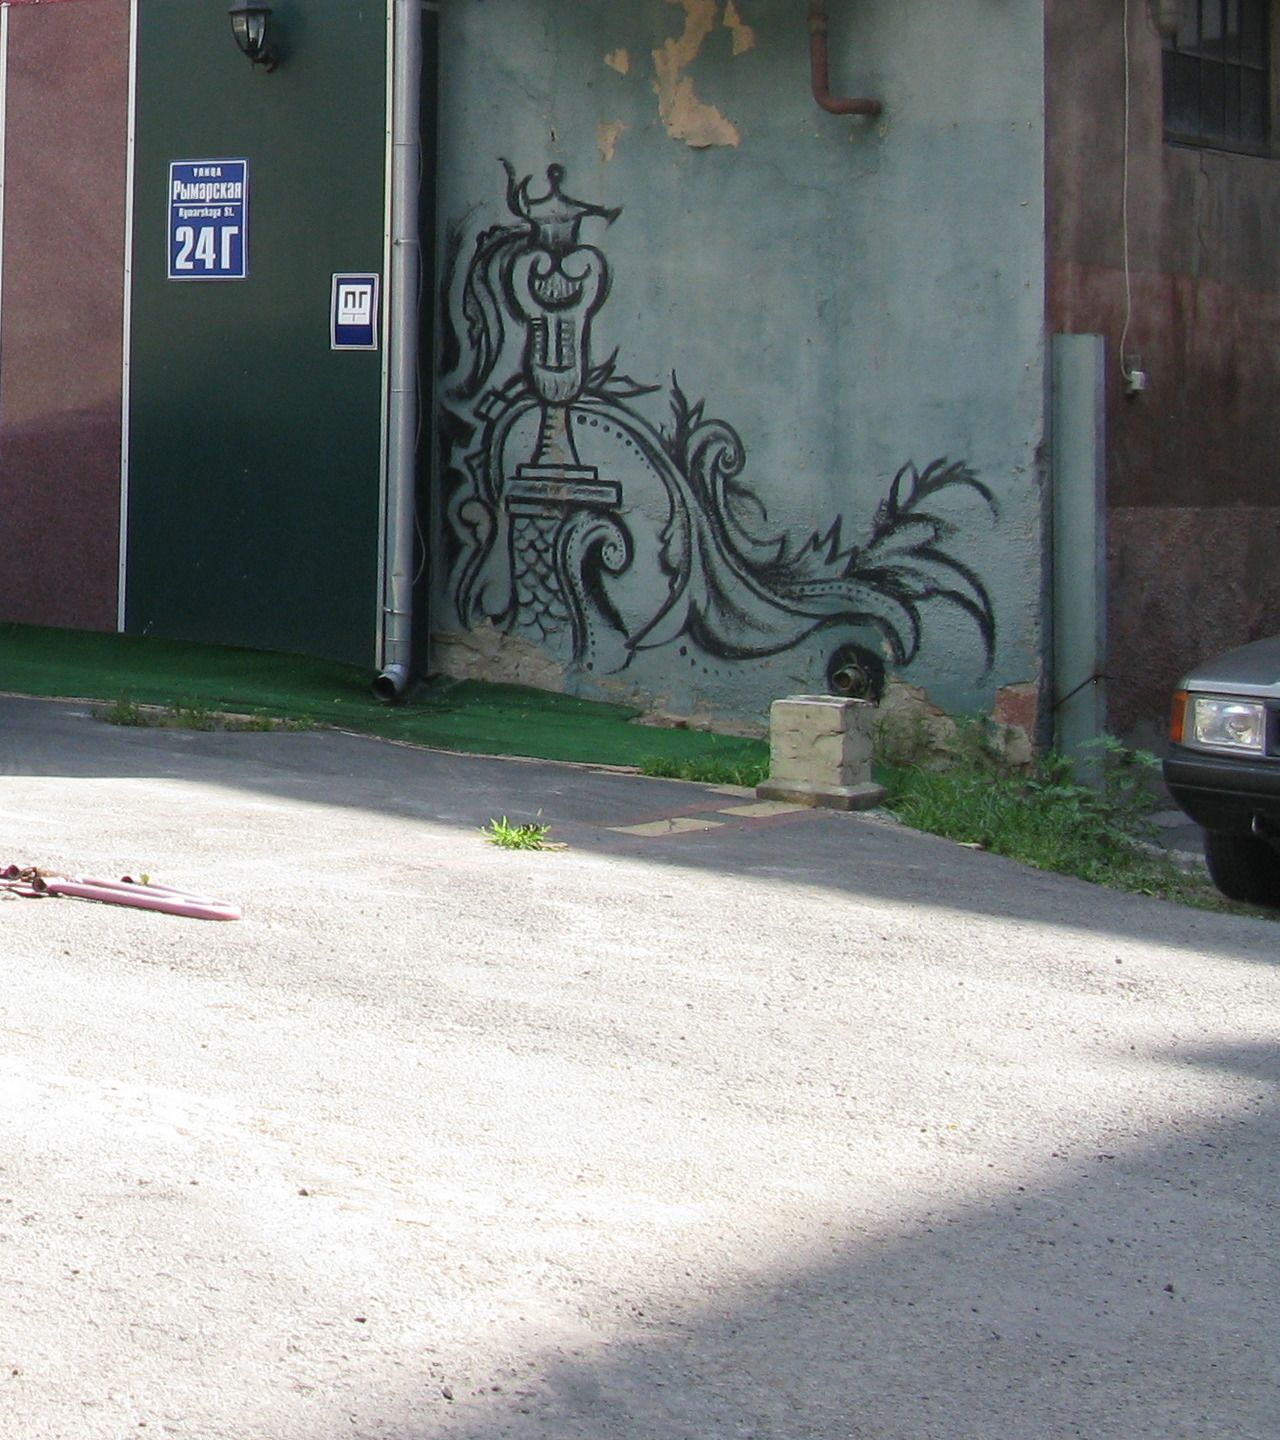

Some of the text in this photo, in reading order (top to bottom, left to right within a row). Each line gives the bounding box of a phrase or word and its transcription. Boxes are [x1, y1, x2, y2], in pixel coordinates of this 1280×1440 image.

[173, 180, 242, 202] Рымарская
[175, 226, 239, 269] 24Г
[344, 291, 368, 308] ПГ
